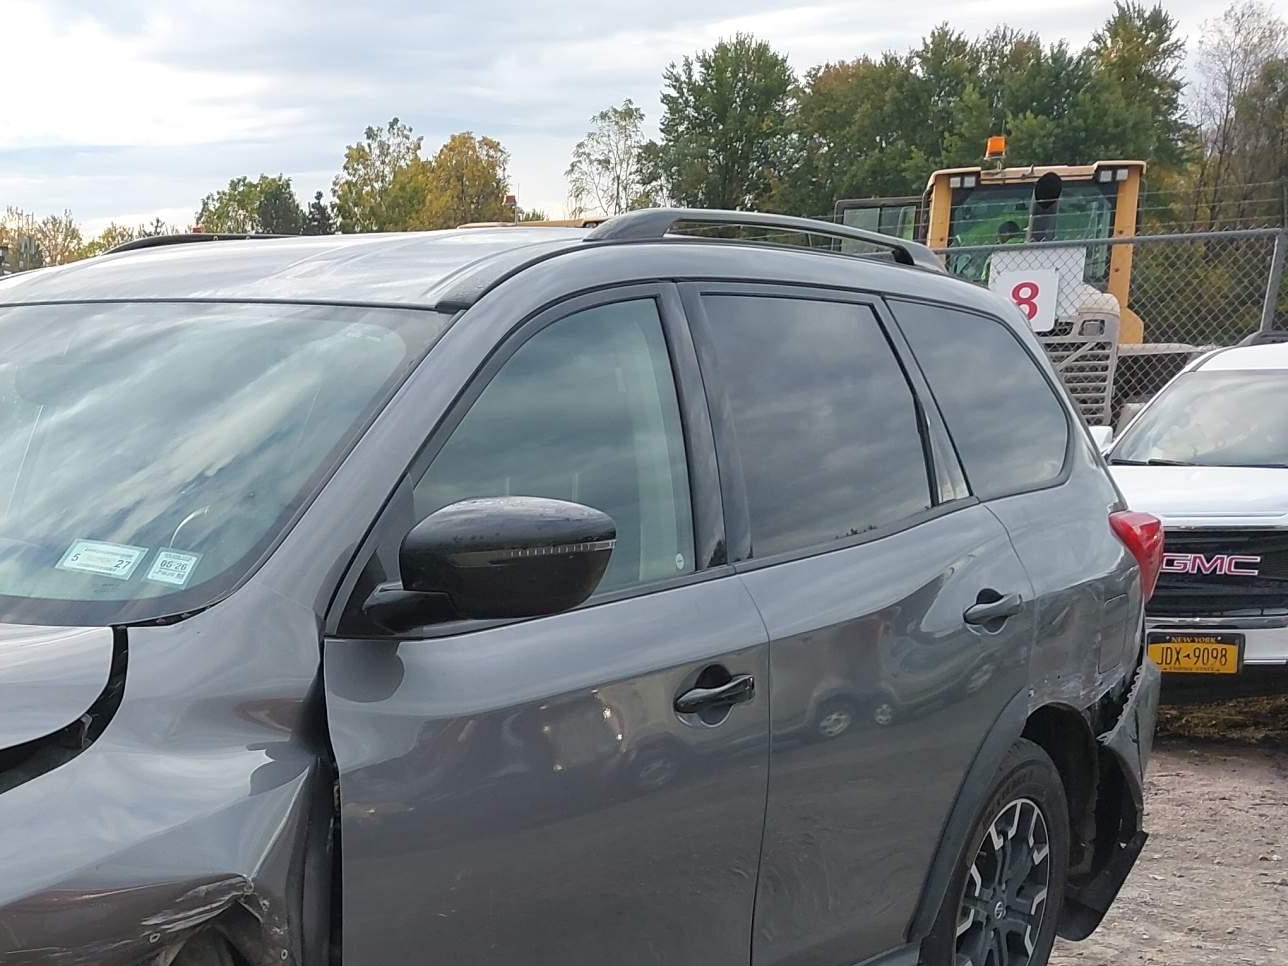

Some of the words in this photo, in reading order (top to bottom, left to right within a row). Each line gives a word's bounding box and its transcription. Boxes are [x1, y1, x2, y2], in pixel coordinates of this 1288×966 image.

[1012, 282, 1039, 320] 8
[71, 552, 81, 562] 5
[113, 559, 132, 569] 27
[1159, 552, 1261, 577] GMC
[1171, 636, 1194, 644] NEW
